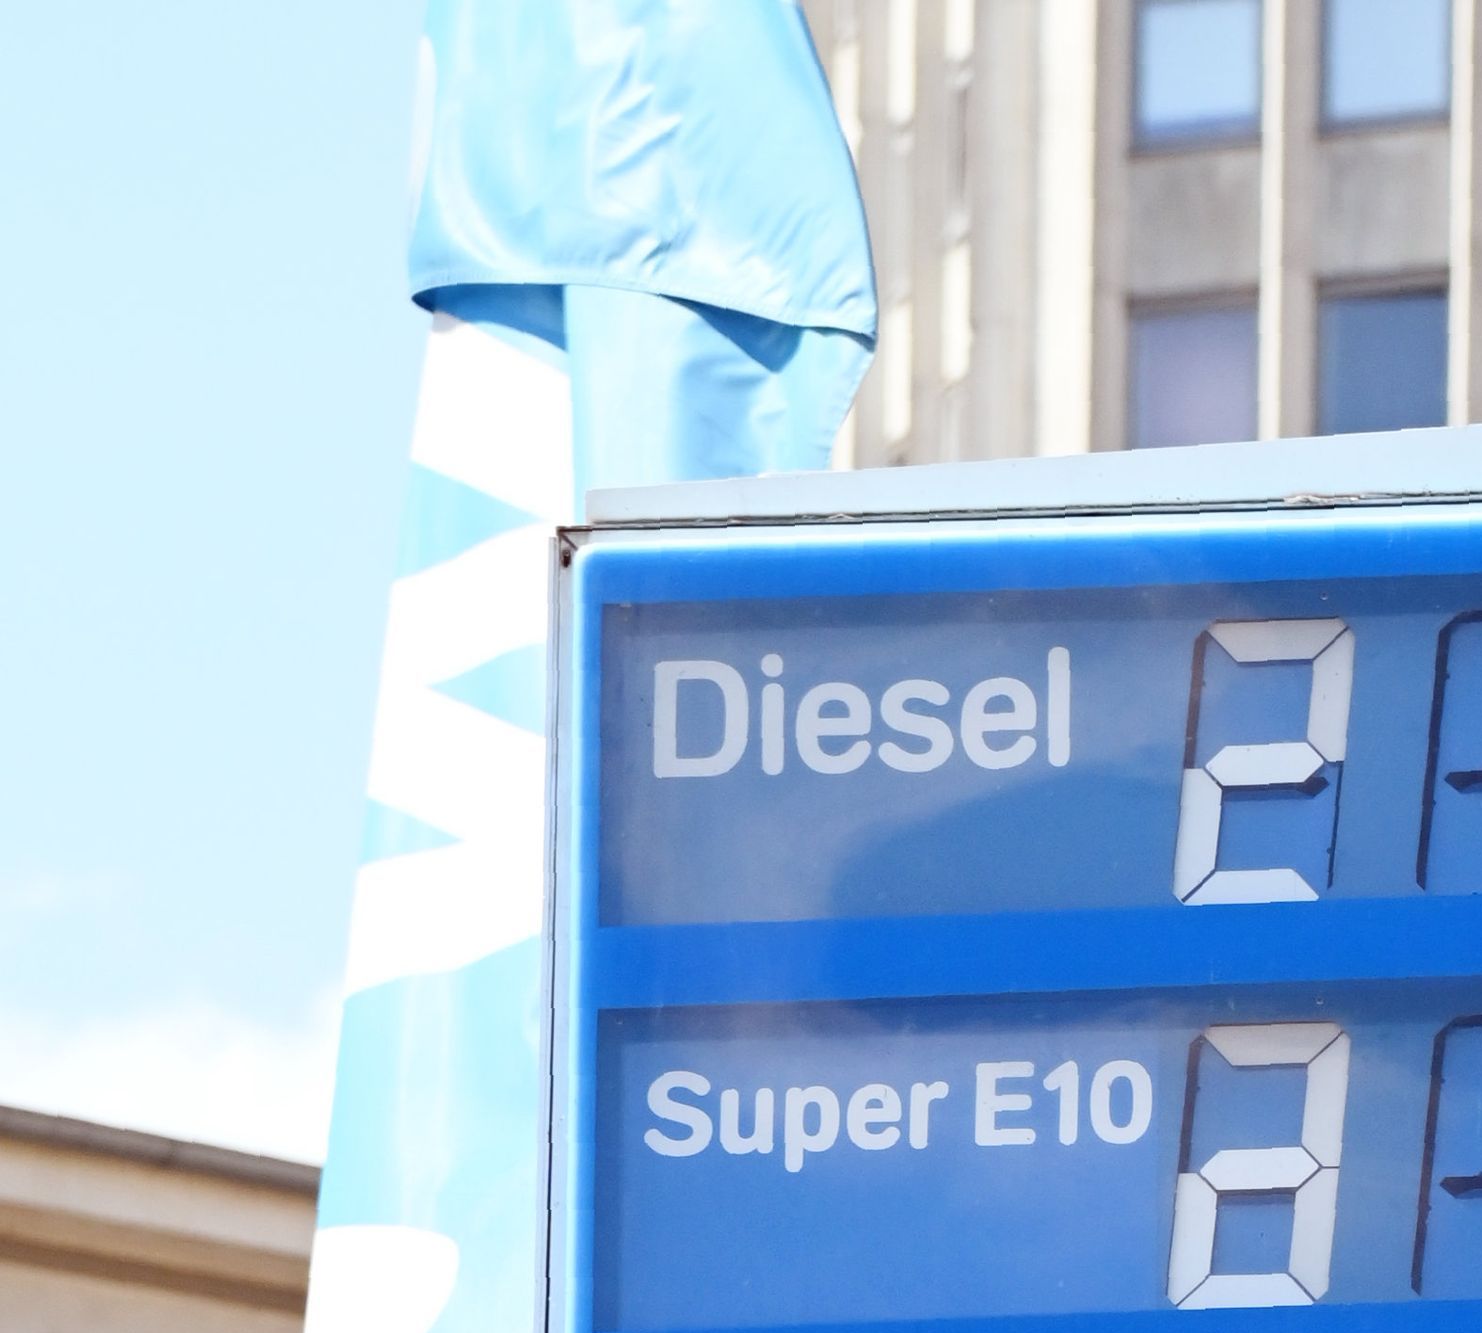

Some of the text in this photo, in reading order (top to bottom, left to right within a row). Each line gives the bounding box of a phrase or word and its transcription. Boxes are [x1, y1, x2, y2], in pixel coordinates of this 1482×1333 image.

[653, 646, 1072, 779] Diesel
[644, 1070, 950, 1173] Super
[974, 1059, 1153, 1147] E10
